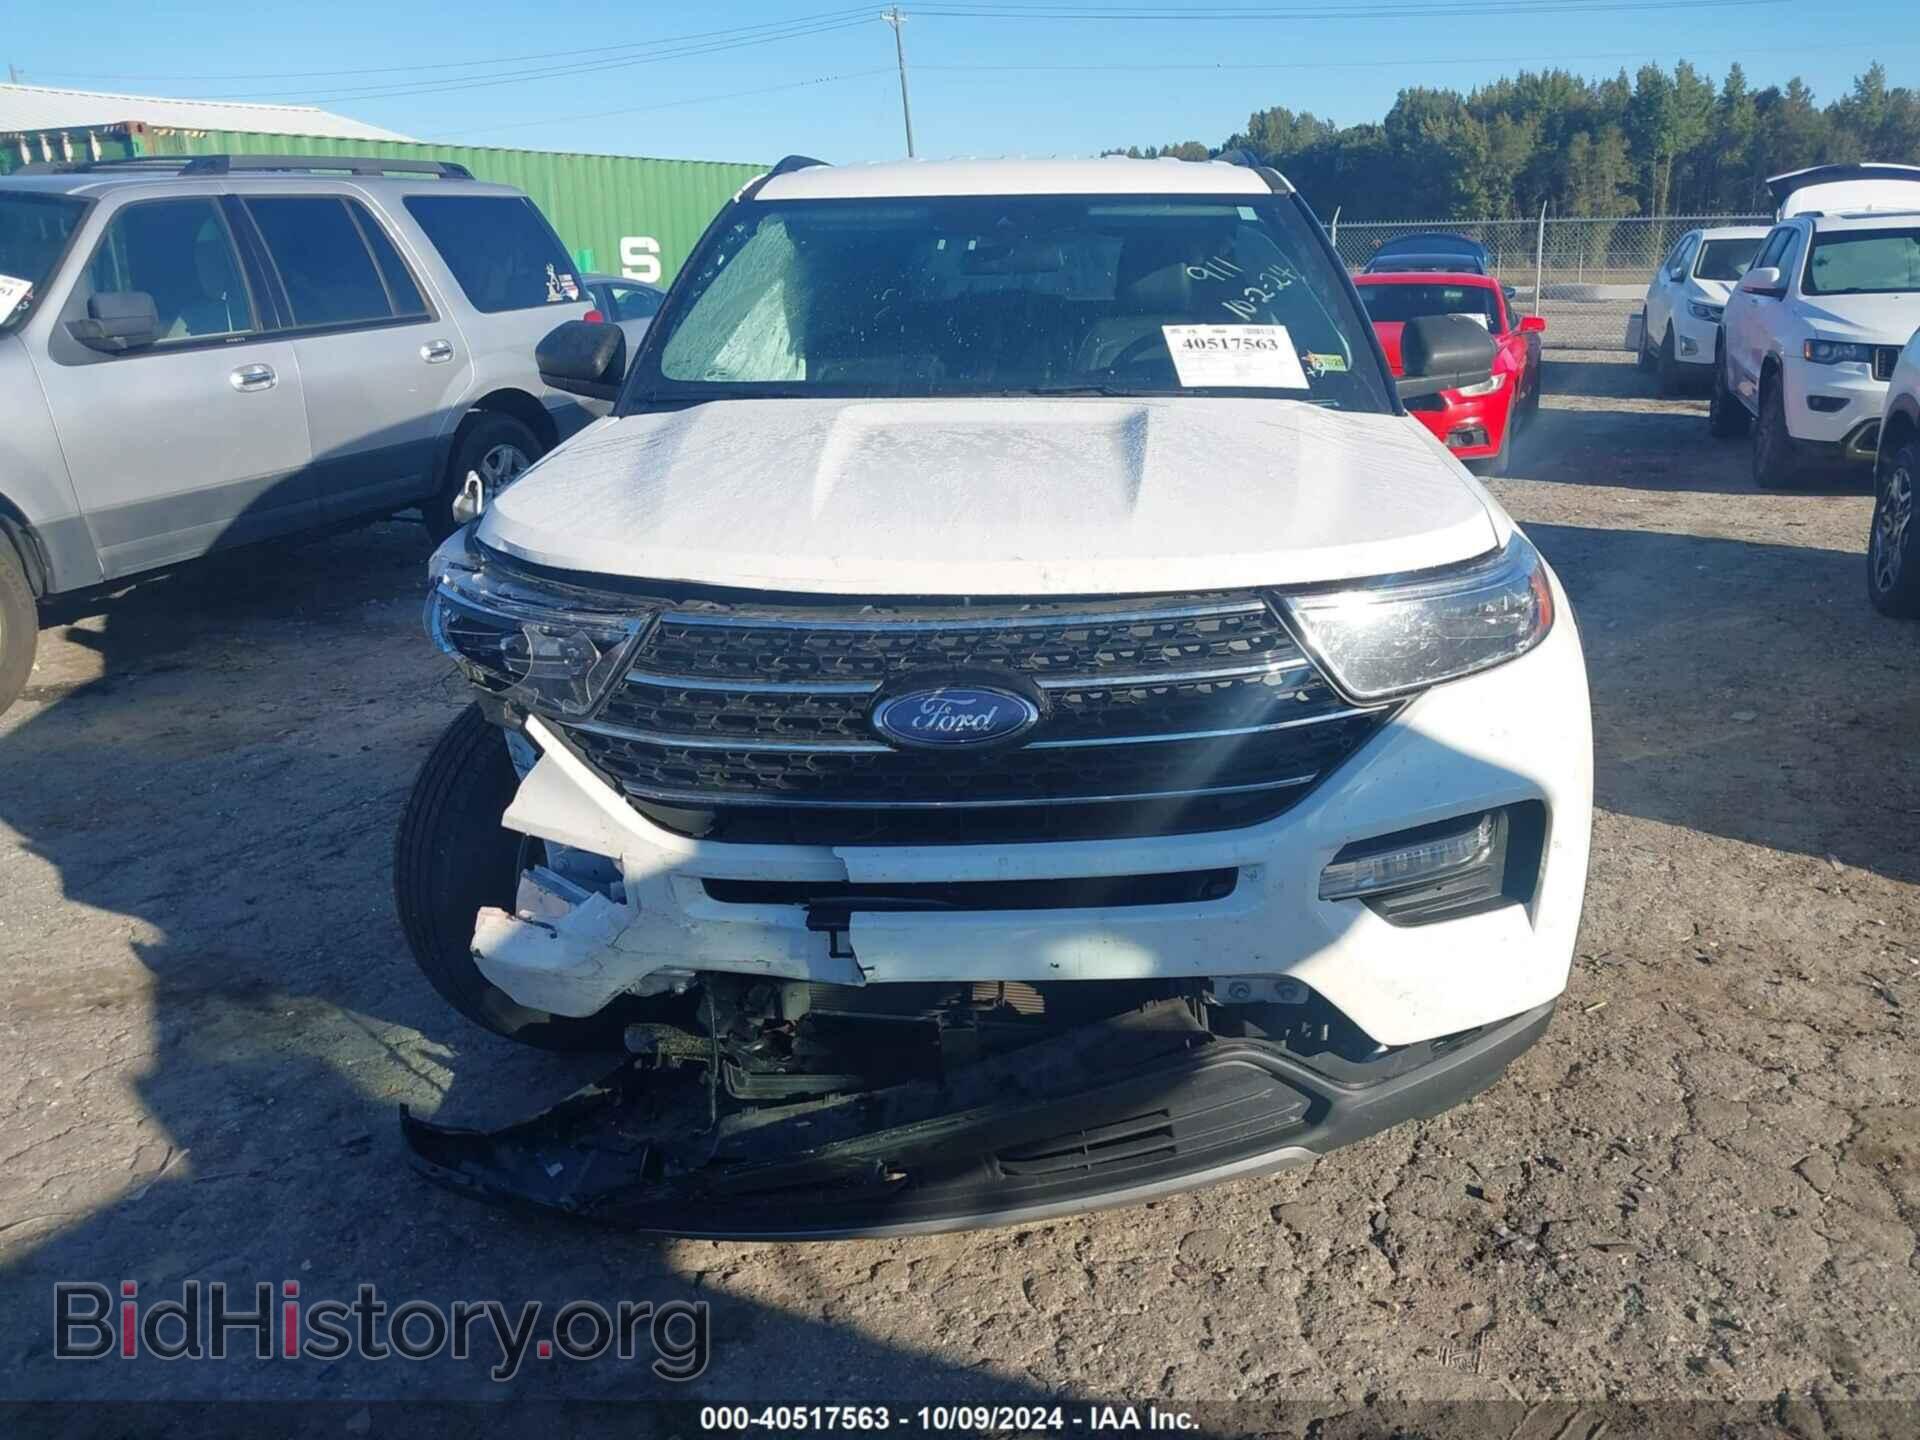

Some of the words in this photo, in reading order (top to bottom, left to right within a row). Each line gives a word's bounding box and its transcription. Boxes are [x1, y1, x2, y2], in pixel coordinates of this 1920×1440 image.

[620, 236, 661, 284] S
[1186, 256, 1244, 281] 911
[1182, 337, 1279, 351] 40517563
[911, 697, 1000, 732] Ford
